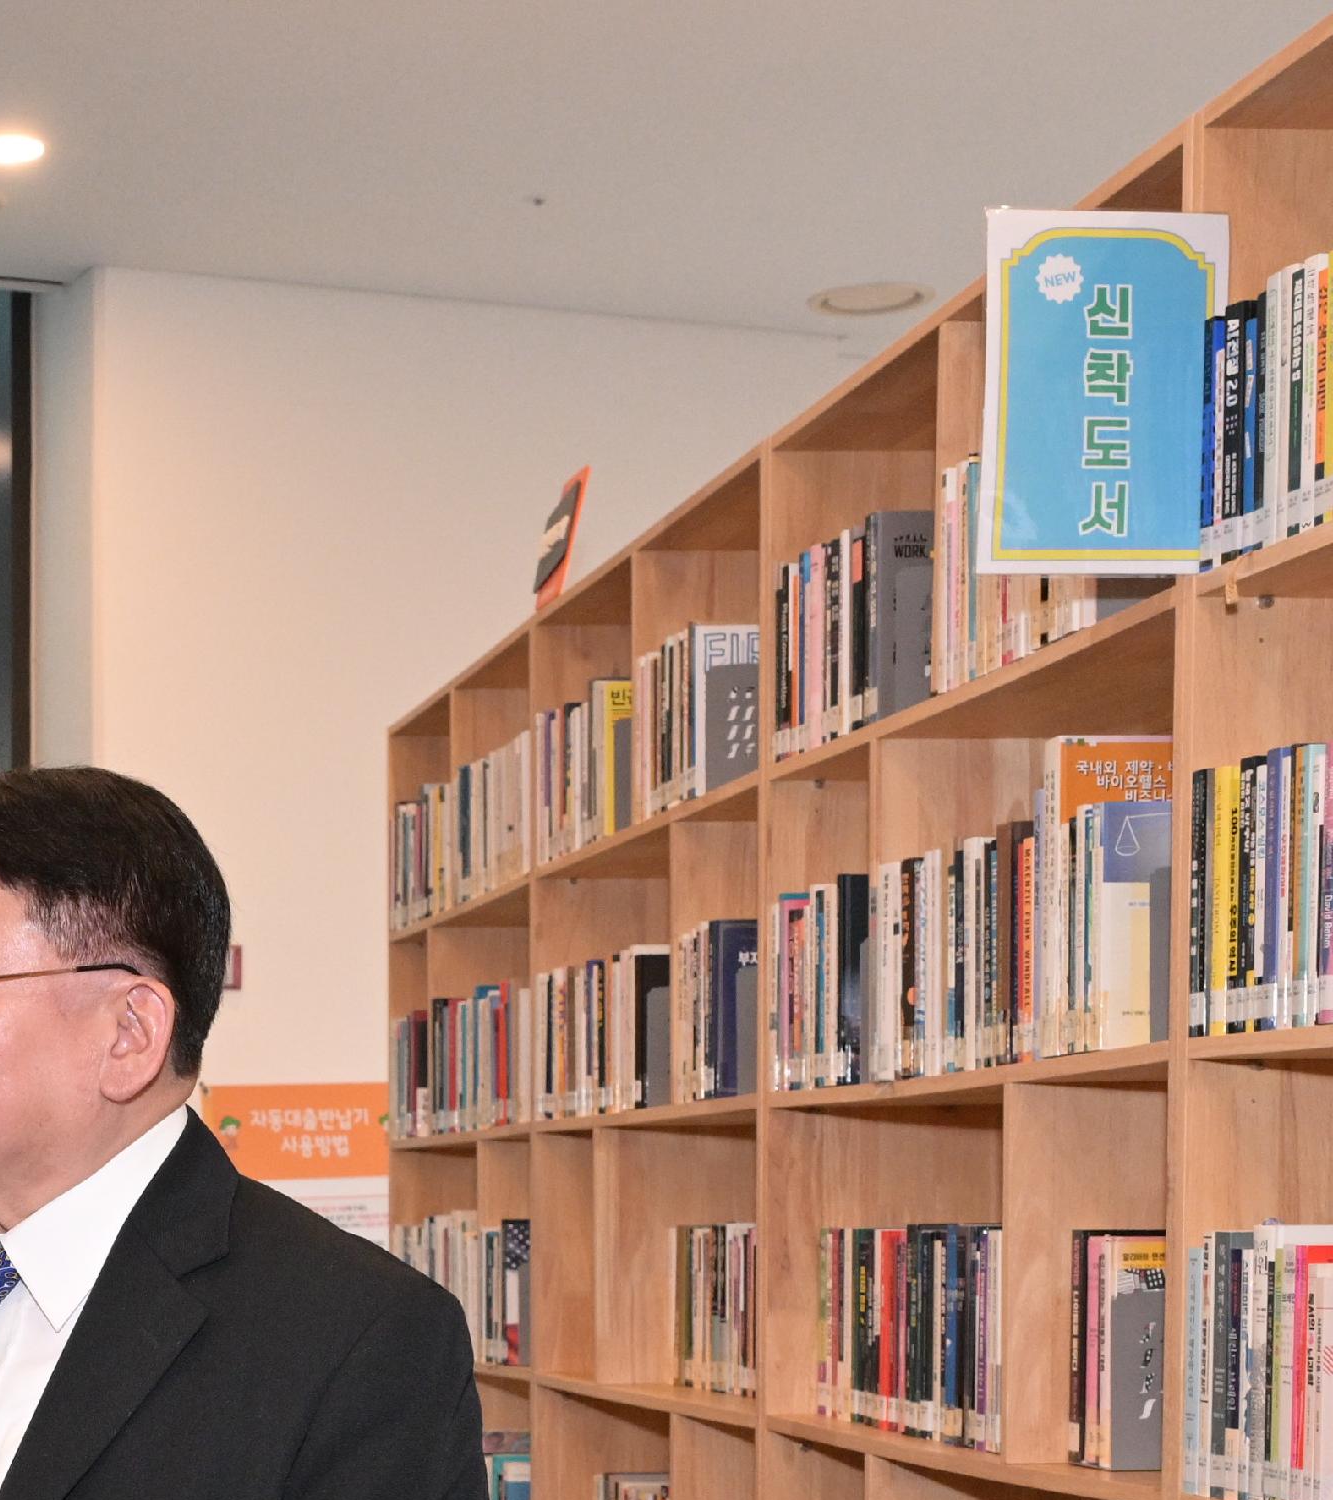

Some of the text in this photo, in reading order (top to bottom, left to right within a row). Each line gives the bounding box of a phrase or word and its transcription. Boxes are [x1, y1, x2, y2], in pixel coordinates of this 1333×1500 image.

[1044, 270, 1076, 287] NEW
[1225, 319, 1239, 408] AI전쟁 2.0
[1079, 282, 1133, 538] 신착도서
[780, 634, 789, 709] Conservation
[1076, 760, 1154, 776] 국내외 제약
[1096, 775, 1167, 791] 바이오헬스
[1324, 894, 1333, 920] David
[249, 1107, 370, 1132] 자동대출반납기
[280, 1135, 351, 1158] 사용방법
